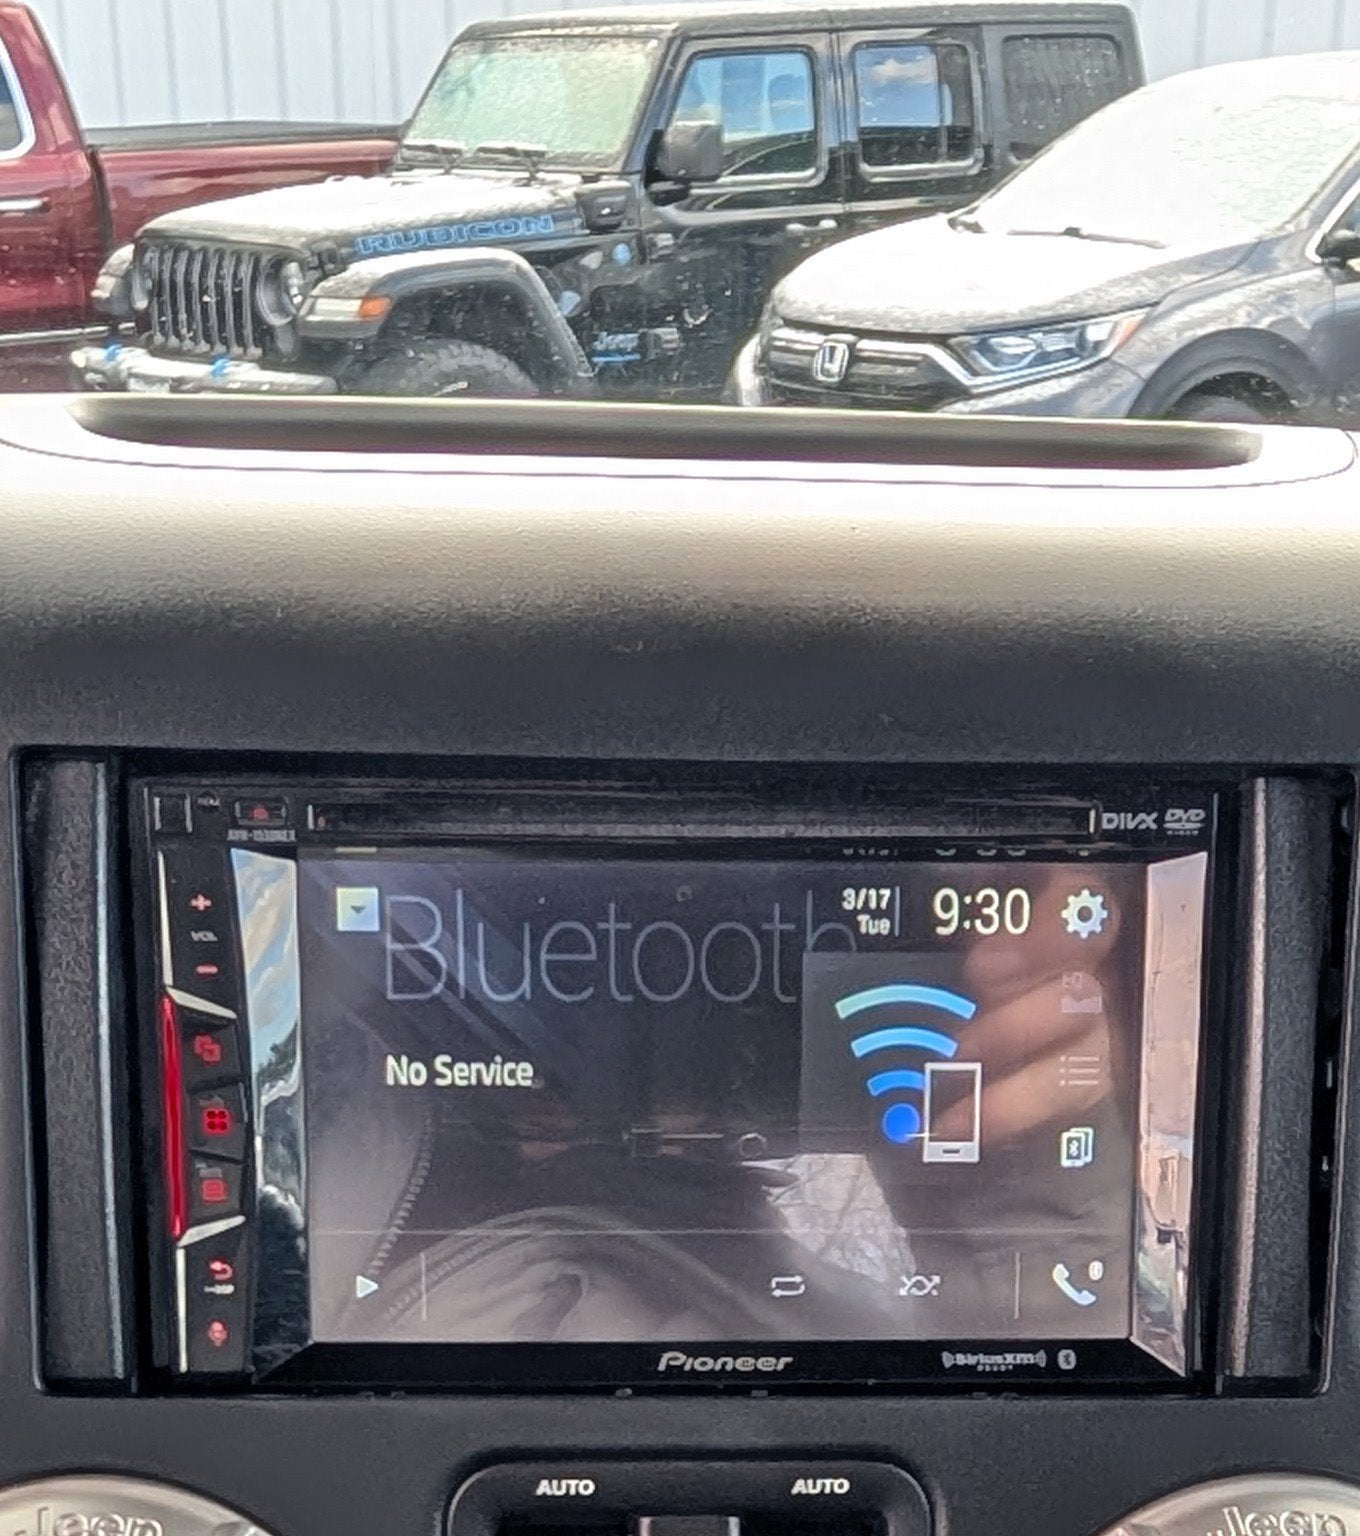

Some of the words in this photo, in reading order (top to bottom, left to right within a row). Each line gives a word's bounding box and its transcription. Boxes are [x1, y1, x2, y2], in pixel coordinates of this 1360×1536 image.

[356, 214, 555, 255] RUBICON
[842, 888, 892, 911] 3/17
[934, 887, 1030, 935] 9:30
[858, 916, 891, 935] Tue
[387, 1056, 427, 1086] No
[435, 1055, 534, 1088] Service
[657, 1350, 793, 1374] Pioneer
[536, 1479, 596, 1496] AUTO
[791, 1478, 850, 1495] AUTO
